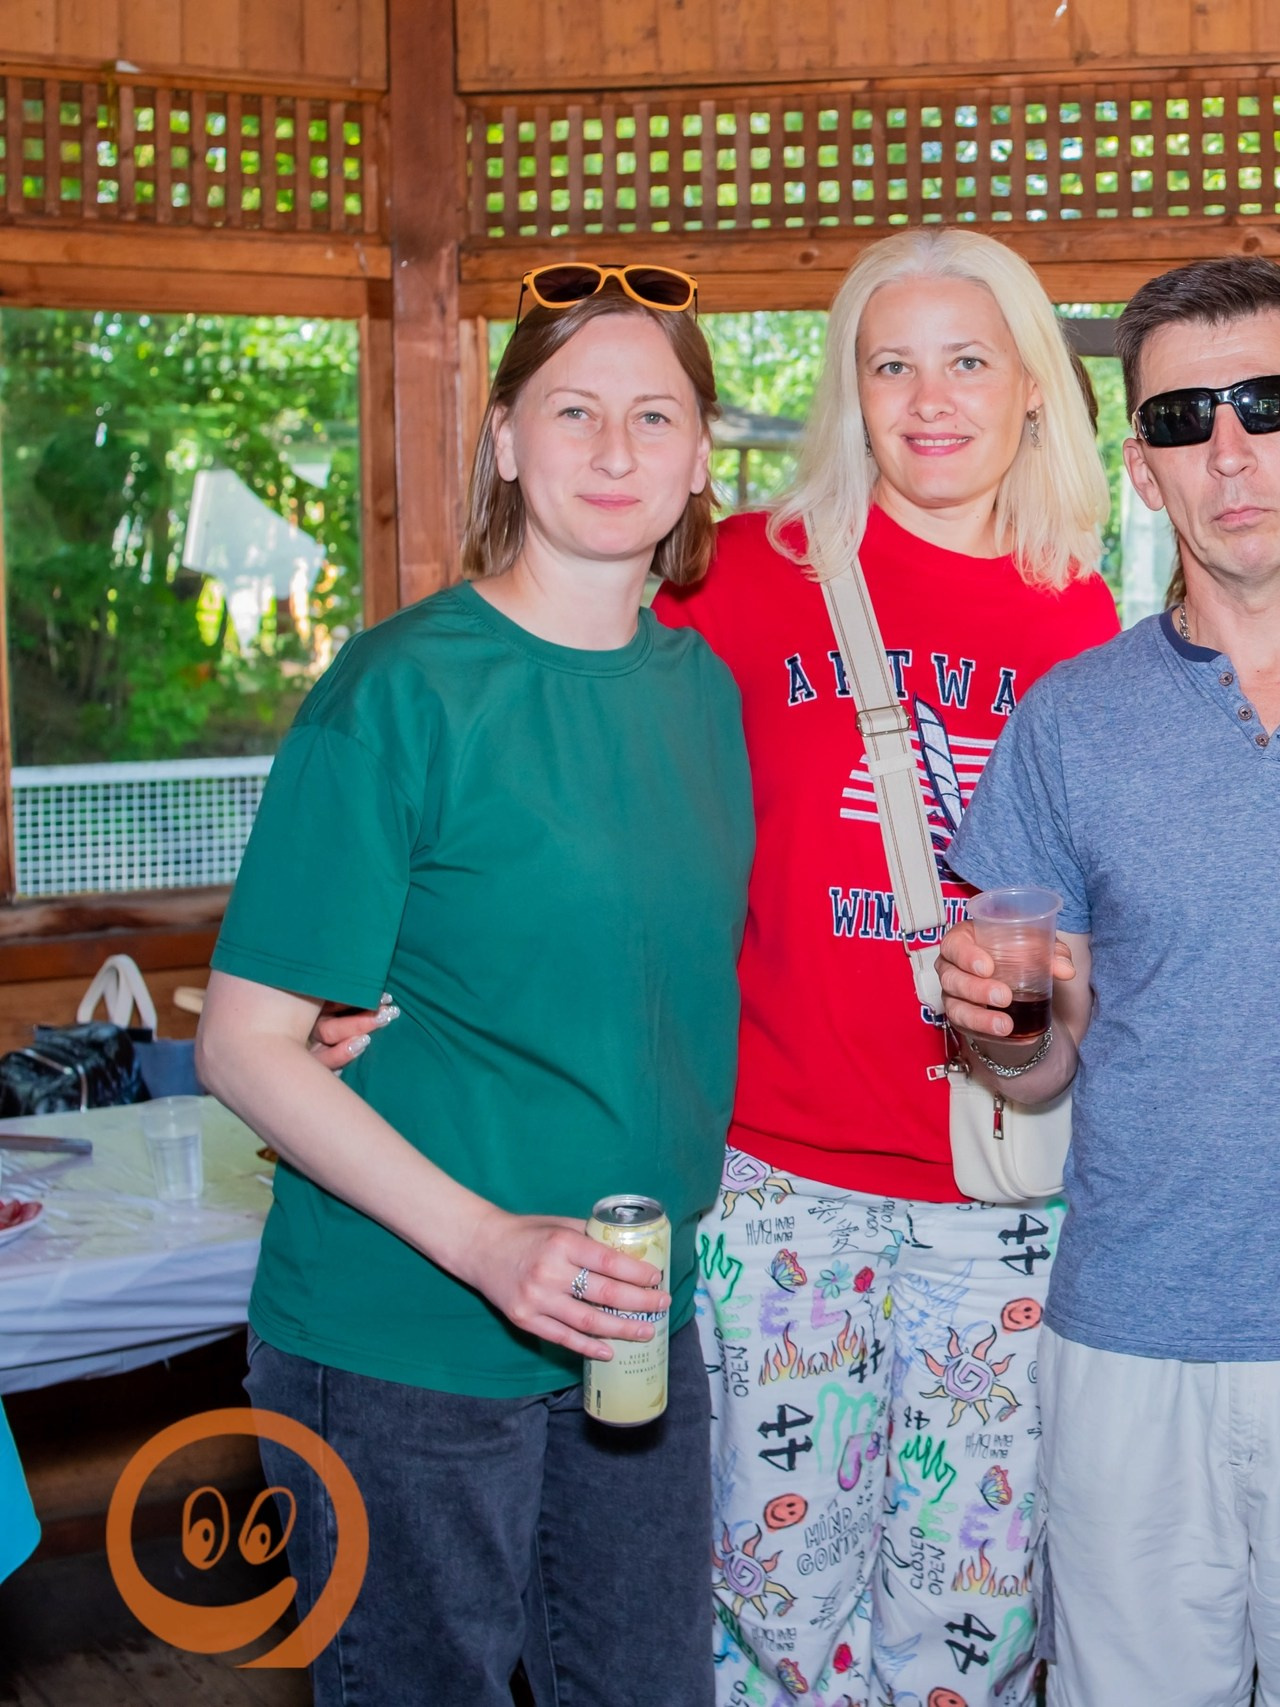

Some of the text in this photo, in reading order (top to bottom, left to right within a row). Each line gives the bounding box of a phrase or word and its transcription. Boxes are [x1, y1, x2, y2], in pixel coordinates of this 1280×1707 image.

[725, 1344, 749, 1397] OPEN
[909, 1526, 926, 1590] CLOSED
[926, 1543, 946, 1596] OPEN
